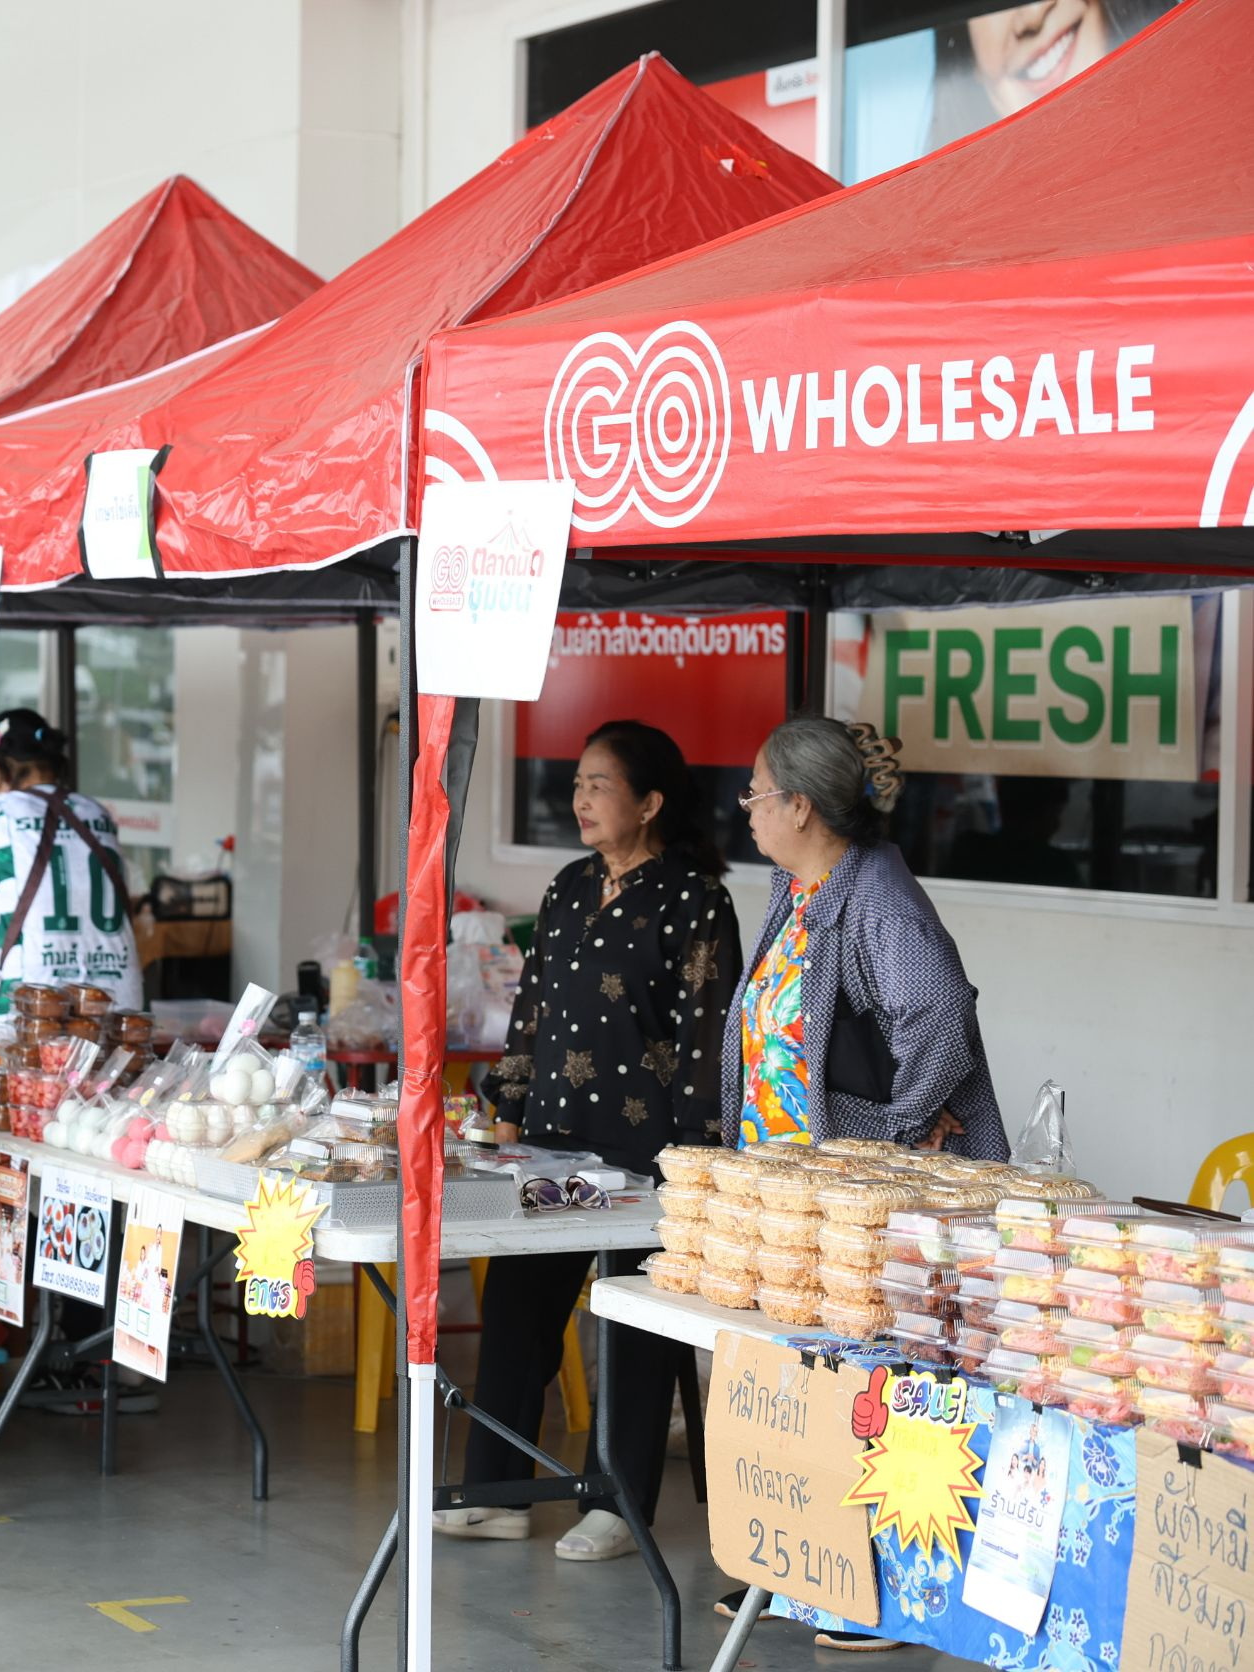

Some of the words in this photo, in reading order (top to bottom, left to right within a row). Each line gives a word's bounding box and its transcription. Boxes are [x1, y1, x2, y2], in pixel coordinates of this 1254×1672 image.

[544, 320, 732, 532] GO
[741, 344, 1155, 454] WHOLESALE
[471, 546, 545, 578] ตลาดนัด
[884, 625, 1179, 745] FRESH
[43, 845, 126, 933] 10
[727, 1360, 807, 1439] หมี่กรอบ
[892, 1379, 961, 1424] SALE
[735, 1451, 812, 1512] กล่องละ
[991, 1489, 1044, 1528] ร้านนี้รับ
[748, 1518, 791, 1578] 25
[799, 1539, 855, 1600] บาท
